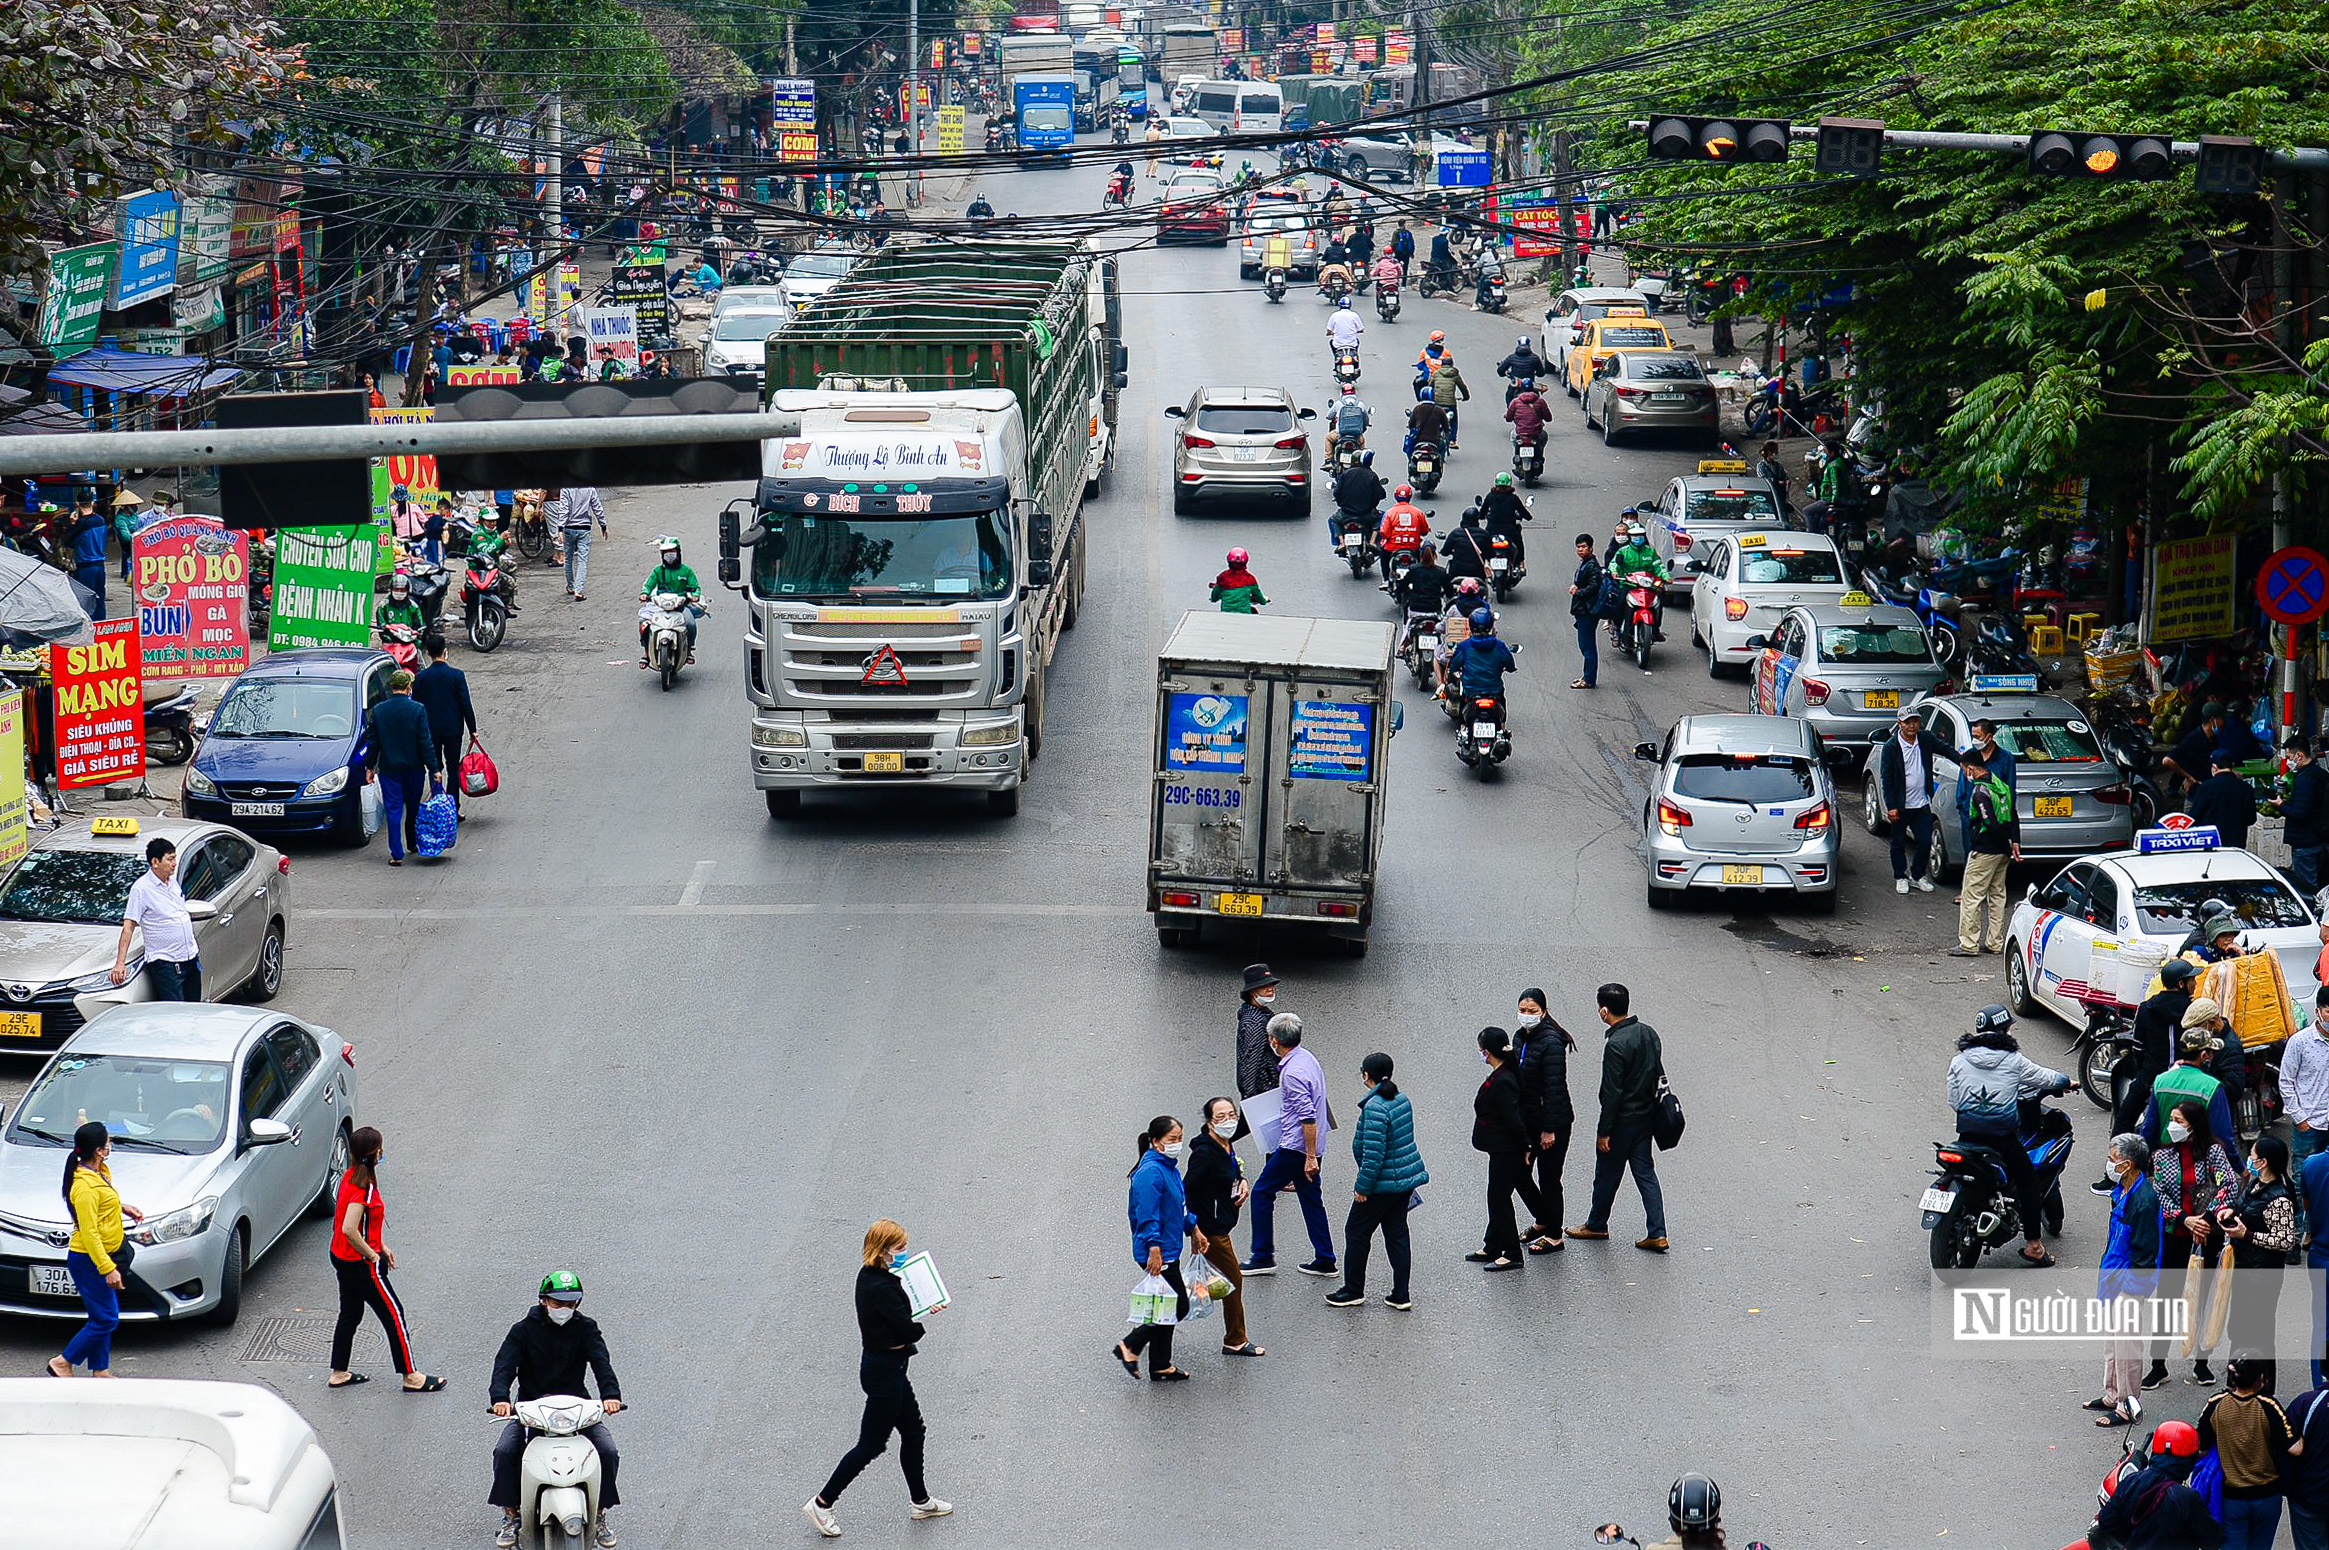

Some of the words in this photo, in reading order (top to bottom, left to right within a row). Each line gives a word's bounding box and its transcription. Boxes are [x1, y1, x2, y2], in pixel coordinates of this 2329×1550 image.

[591, 313, 607, 336] NHÀ
[607, 309, 631, 336] THUỐC
[145, 346, 174, 356] 152
[825, 445, 870, 470] Thượng
[872, 444, 890, 470] Lộ
[894, 443, 924, 466] Bình
[927, 445, 948, 466] An
[828, 489, 860, 512] BÍCH
[1744, 536, 1763, 545] TAXI
[325, 530, 347, 571] SỮA
[349, 539, 373, 573] CHO
[139, 543, 198, 585] PHỞ
[204, 545, 243, 583] BÒ
[188, 583, 223, 600] MÓNG
[226, 583, 247, 599] GIÒ
[277, 578, 314, 625] BỆNH
[315, 584, 354, 624] NHÂN
[355, 592, 367, 625] K
[141, 600, 182, 636] BÚN
[207, 604, 228, 621] GÀ
[202, 628, 234, 645] MỌC
[292, 635, 318, 647] 0984
[67, 639, 127, 676] SIM
[142, 643, 186, 662] MIẾN
[191, 646, 243, 661] NGAN
[141, 665, 160, 677] CƠM
[161, 665, 184, 676] RANG
[190, 662, 207, 675] PHỞ
[228, 662, 245, 674] XÀO
[1998, 676, 2016, 687] SÔNG
[57, 676, 139, 721] MẠNG
[67, 724, 93, 740] SIÊU
[95, 718, 133, 736] KHỦNG
[59, 744, 79, 760] ĐIỆN
[79, 741, 102, 757] THOẠI
[108, 736, 123, 752] ĐĨA
[63, 759, 87, 776] GIÁ
[89, 755, 119, 773] SIÊU
[122, 748, 139, 766] RẺ
[874, 754, 891, 762] 98H
[1165, 785, 1241, 808] 29C-663.39
[2045, 798, 2061, 807] 30F
[232, 804, 284, 815] 29A-214.62
[2038, 806, 2069, 816] 422.65
[98, 819, 129, 829] TAXI
[1727, 874, 1758, 883] 412.39
[1232, 894, 1251, 904] 29C
[1224, 904, 1258, 914] 663.39
[9, 1013, 29, 1024] 29E
[0, 1024, 36, 1036] 025.74
[45, 1269, 68, 1282] 30A
[36, 1281, 79, 1295] 176.63
